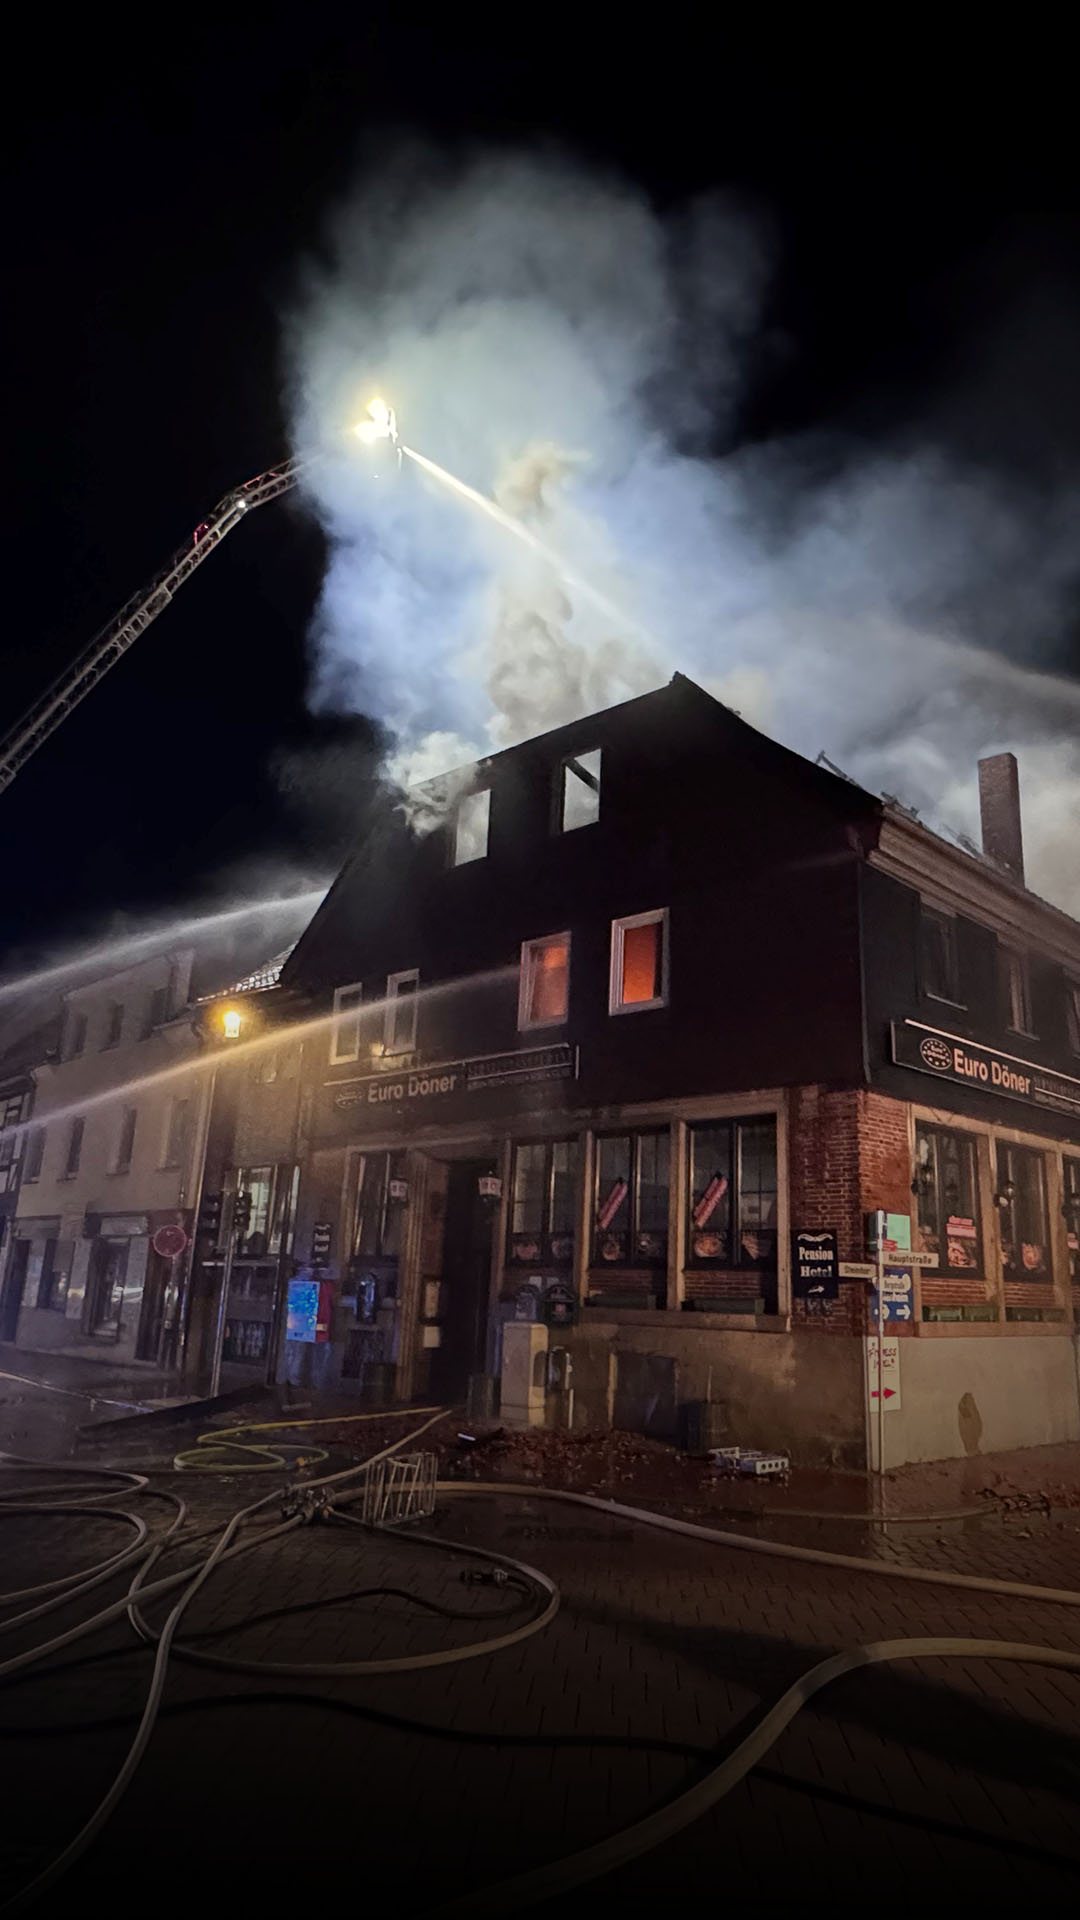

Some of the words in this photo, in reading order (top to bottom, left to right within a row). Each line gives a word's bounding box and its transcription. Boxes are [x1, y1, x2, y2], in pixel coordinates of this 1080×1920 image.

[954, 1048, 988, 1081] Euro
[991, 1061, 1031, 1094] Döner
[368, 1083, 403, 1103] Euro
[408, 1074, 457, 1097] Döner
[798, 1245, 834, 1260] Pension
[888, 1253, 932, 1265] Hauptstraße
[800, 1265, 832, 1277] Hotel
